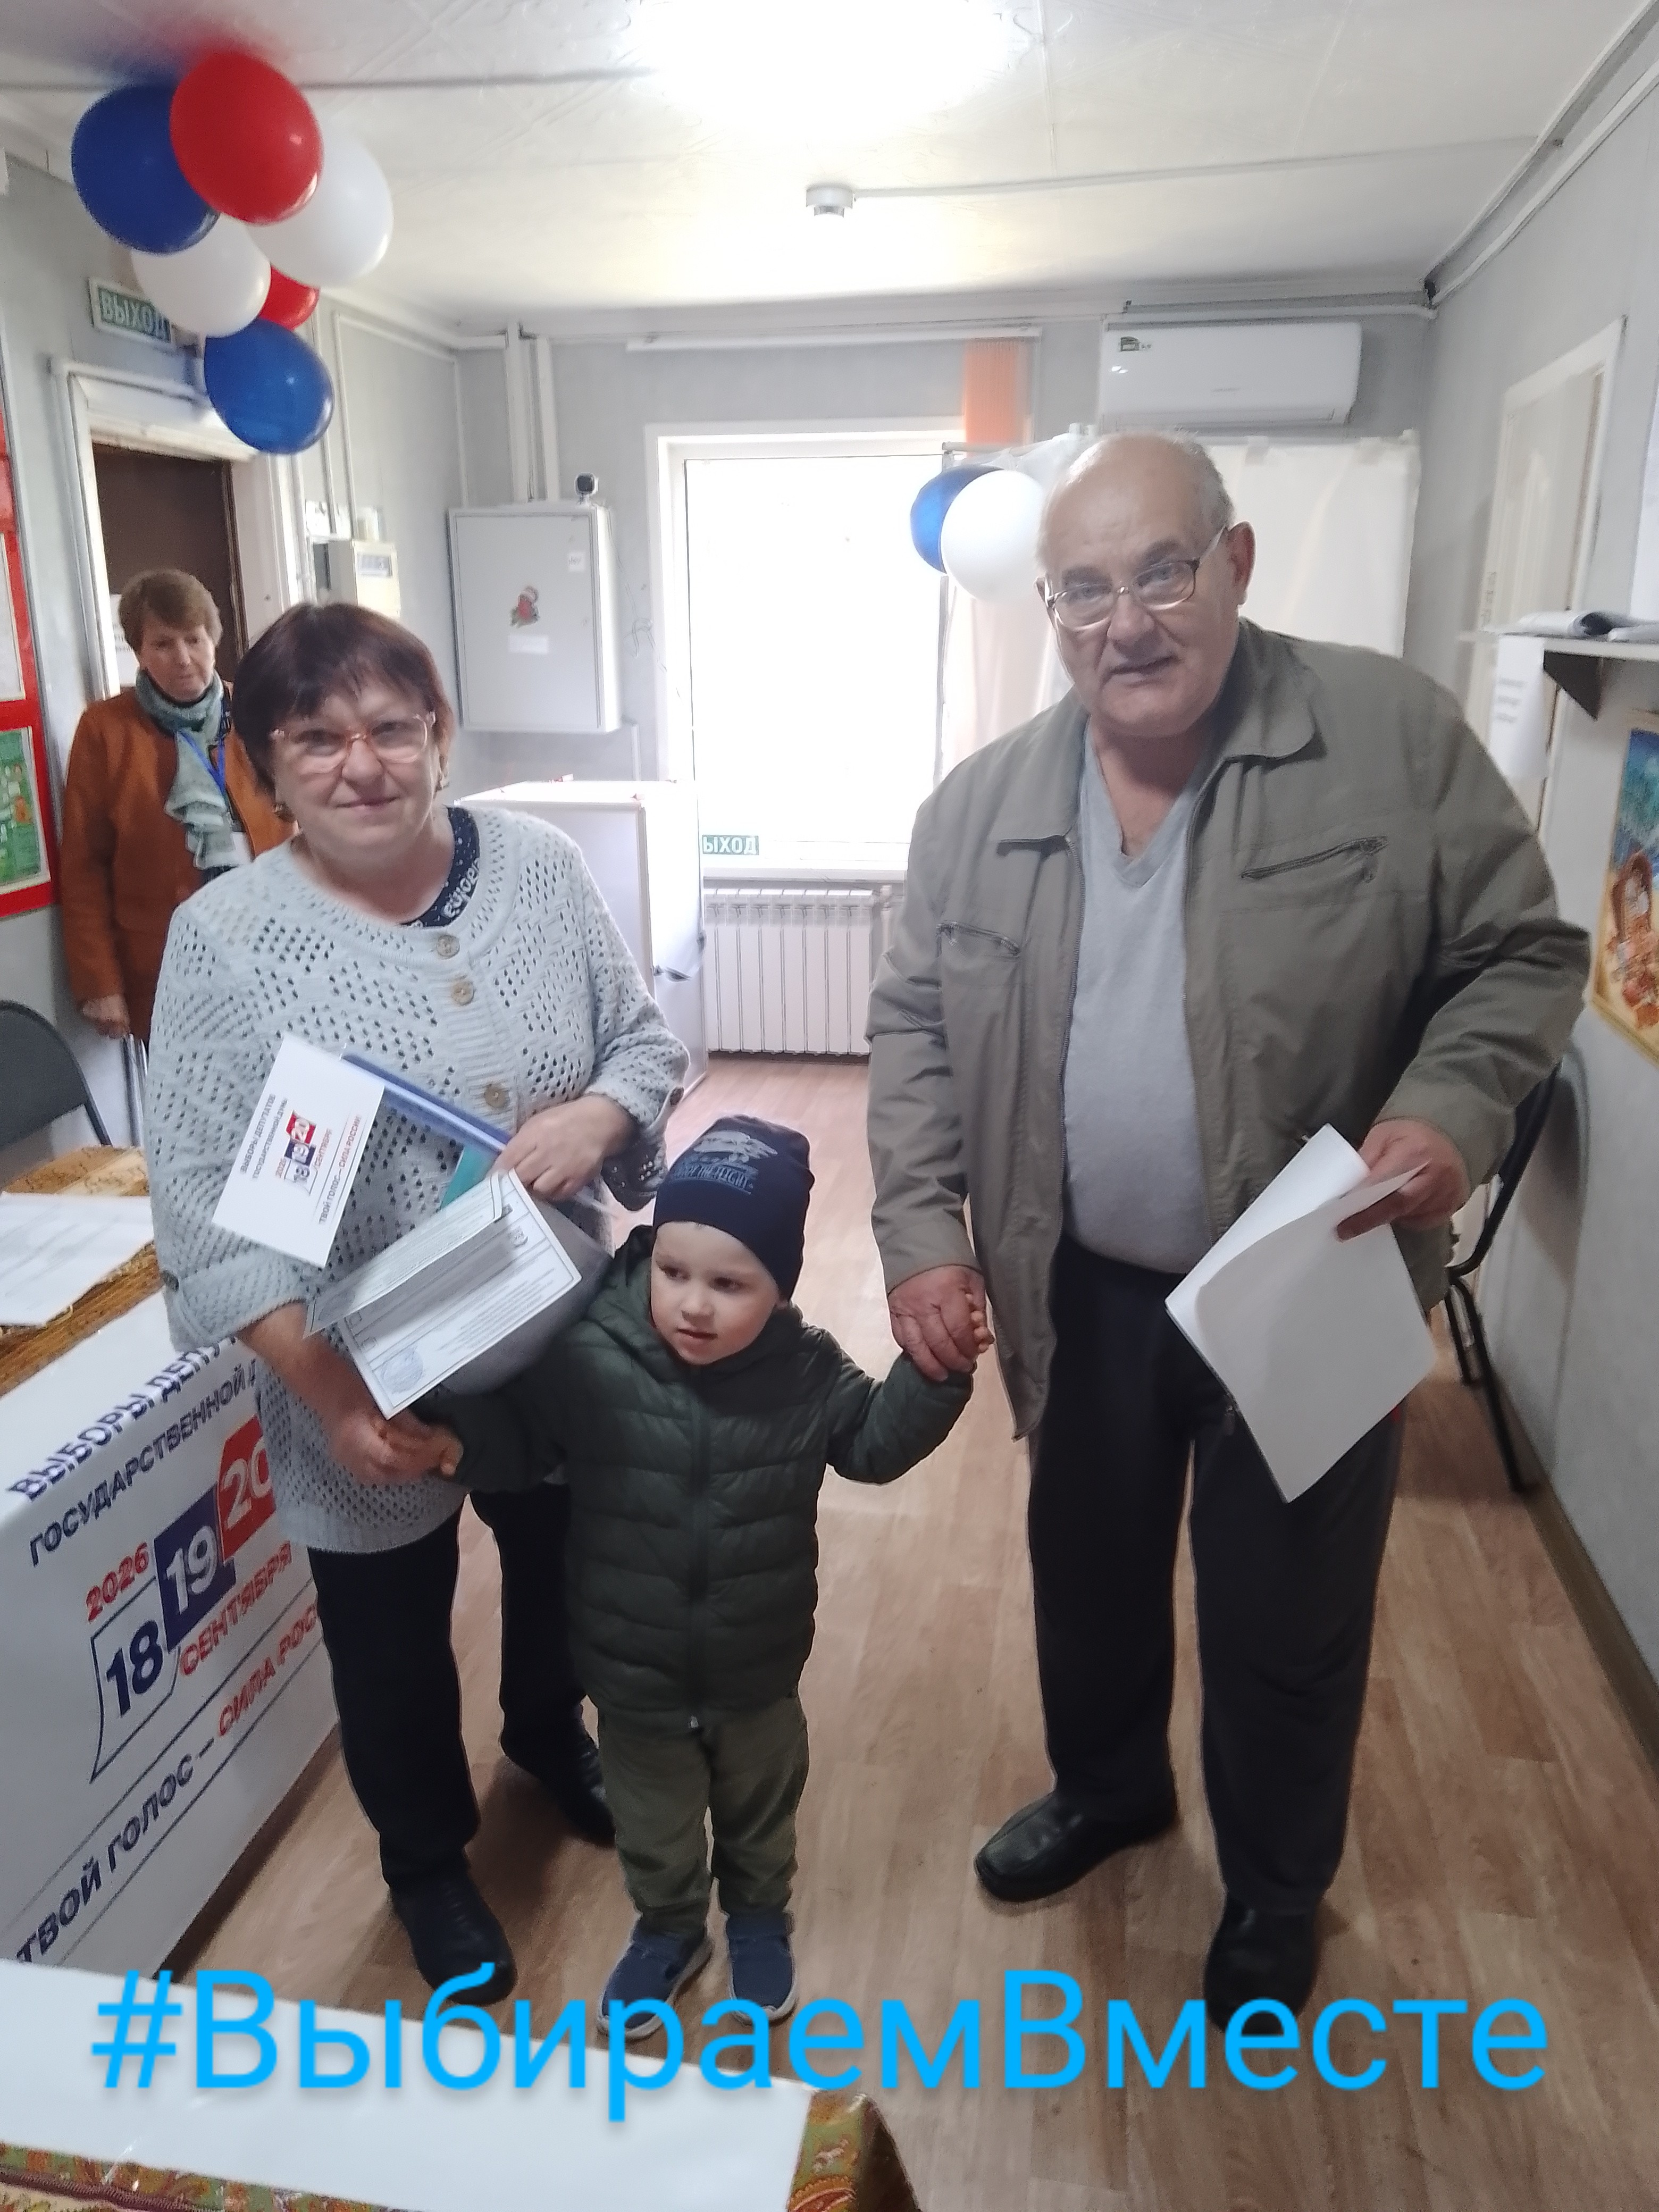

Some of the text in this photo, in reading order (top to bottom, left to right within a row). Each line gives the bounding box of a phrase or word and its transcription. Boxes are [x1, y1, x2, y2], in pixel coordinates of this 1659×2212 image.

[240, 1136, 261, 1174] ВЫБОРЫ
[291, 1118, 310, 1143] 20
[291, 1143, 309, 1164] 19
[294, 1163, 310, 1184] 18
[319, 1201, 331, 1224] ТВОЙ
[326, 1175, 341, 1203] ГОЛОС
[339, 1149, 350, 1168] СИЛА
[348, 1115, 362, 1146] РОССИИ
[12, 1394, 156, 1502] ВЫБОРЫ
[30, 1363, 246, 1566] ГОСУДАРСТВЕННОЙ
[86, 1544, 149, 1623] 2026
[166, 1525, 219, 1614] 19
[180, 1541, 292, 1676] СЕНТЯБРЯ
[106, 1621, 163, 1717] 18
[16, 1857, 102, 1963] ТВОЙ
[108, 1755, 193, 1872] ГОЛОС
[218, 1658, 276, 1736] СИЛА
